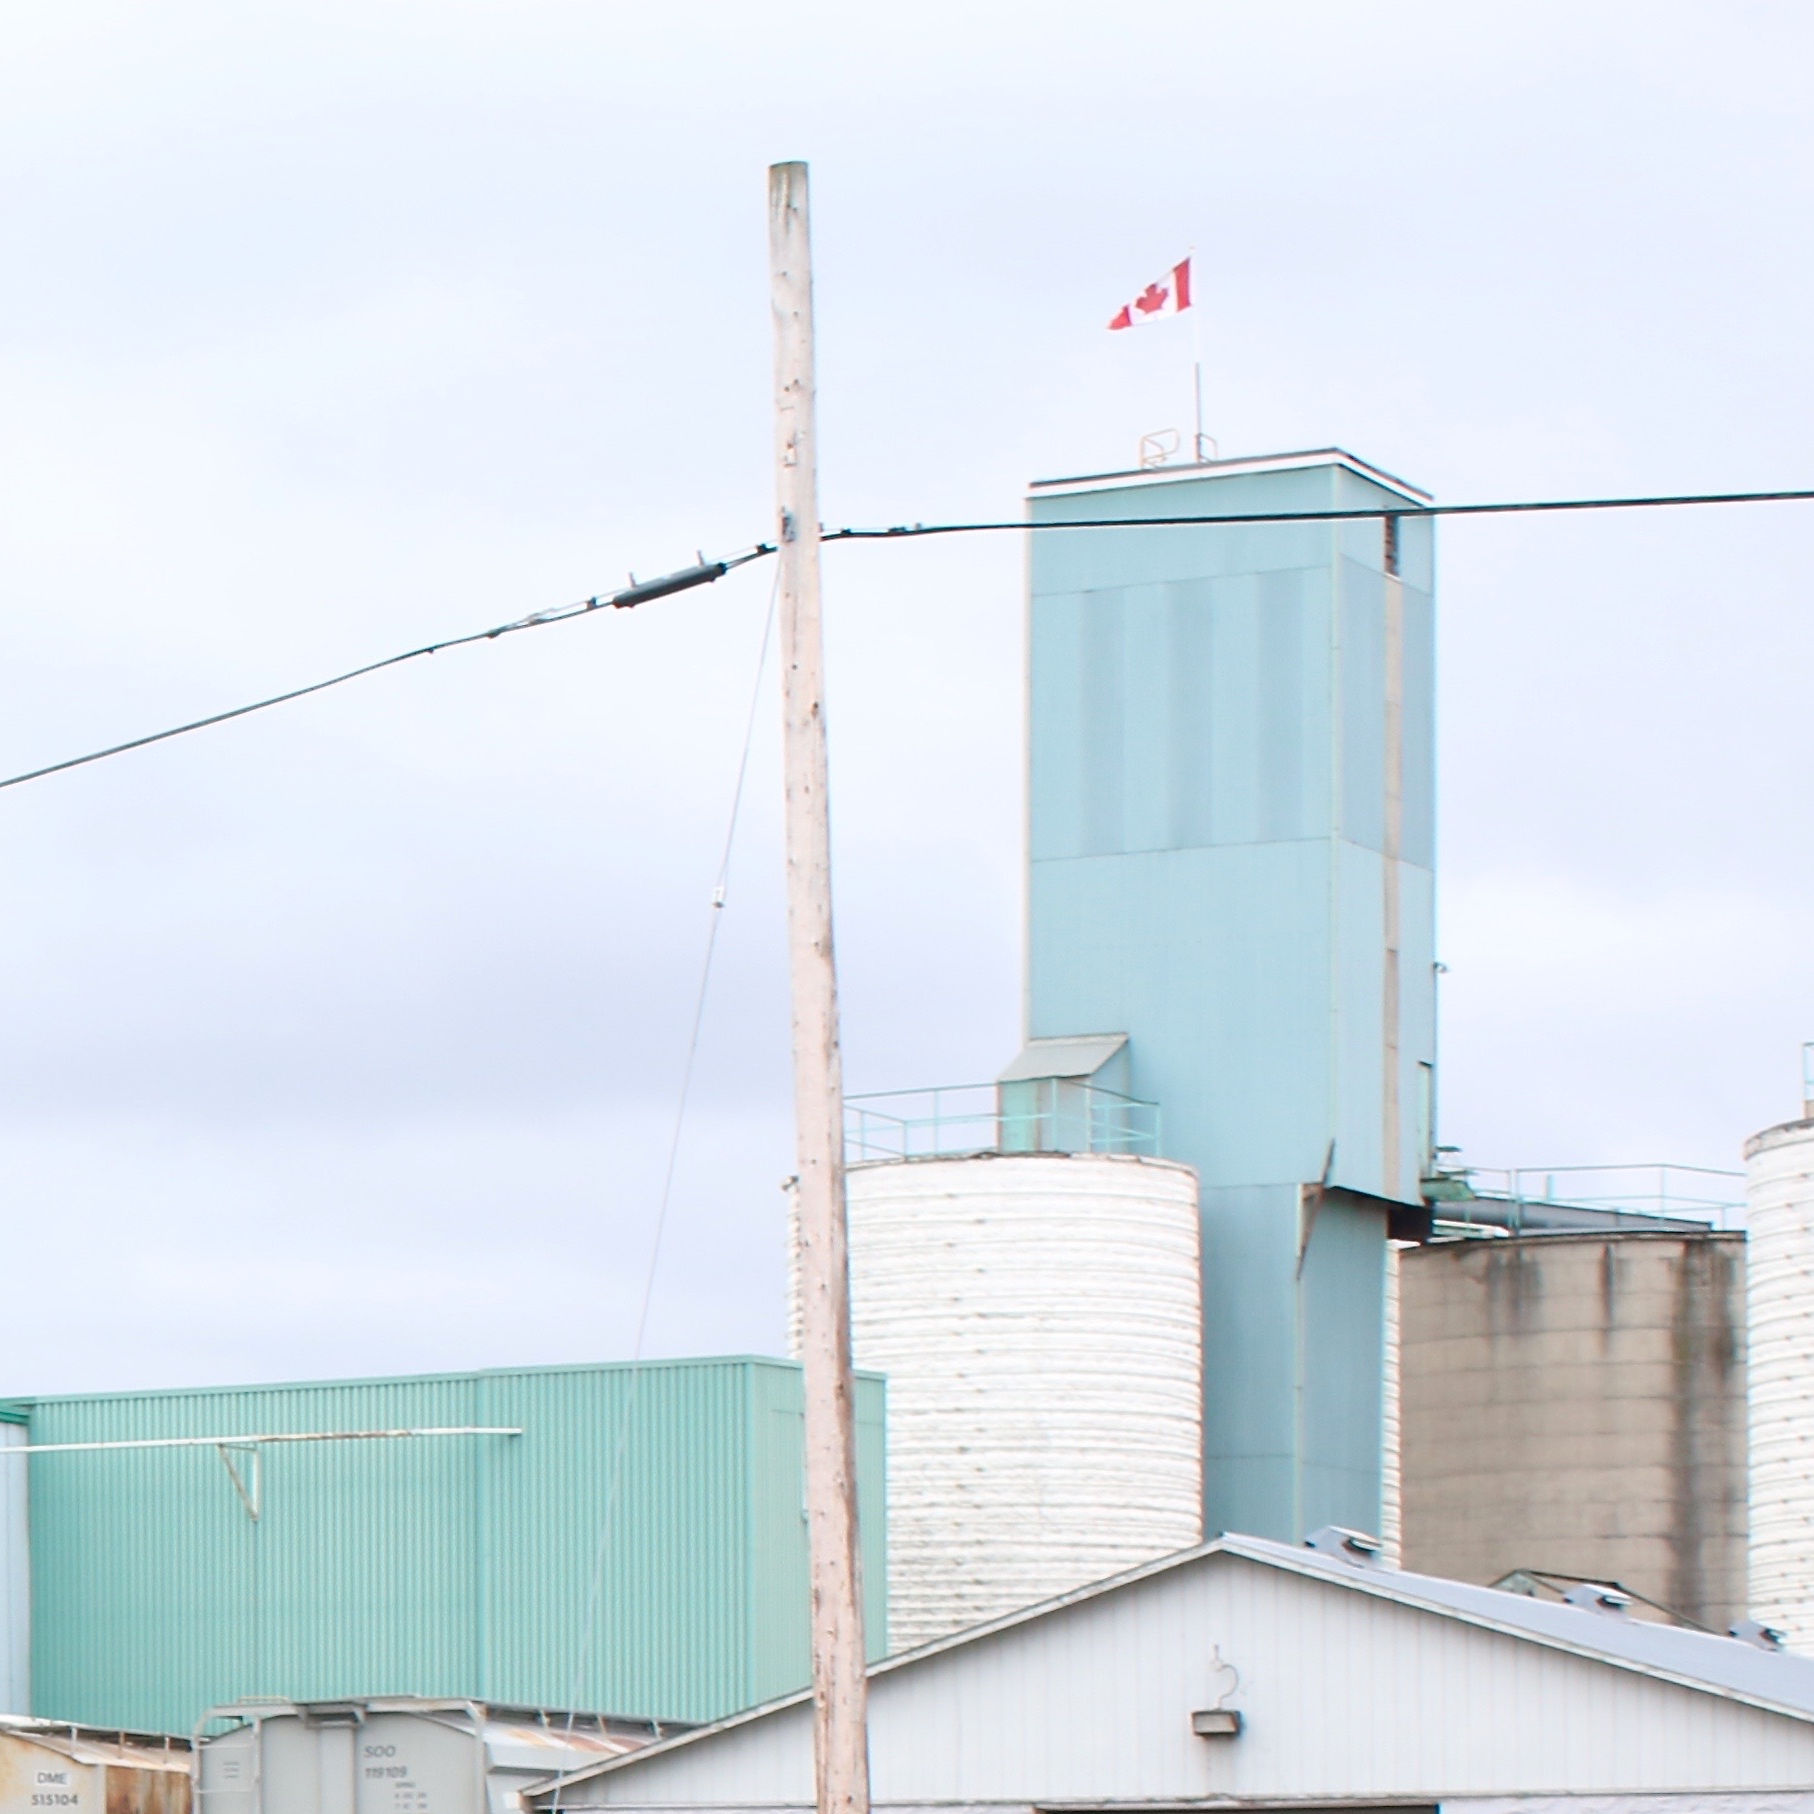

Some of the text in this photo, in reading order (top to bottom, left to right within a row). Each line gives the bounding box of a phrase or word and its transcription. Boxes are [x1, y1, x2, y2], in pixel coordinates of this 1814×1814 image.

[364, 1744, 396, 1758] SOO
[37, 1772, 68, 1785] DME
[32, 1793, 78, 1806] 515104
